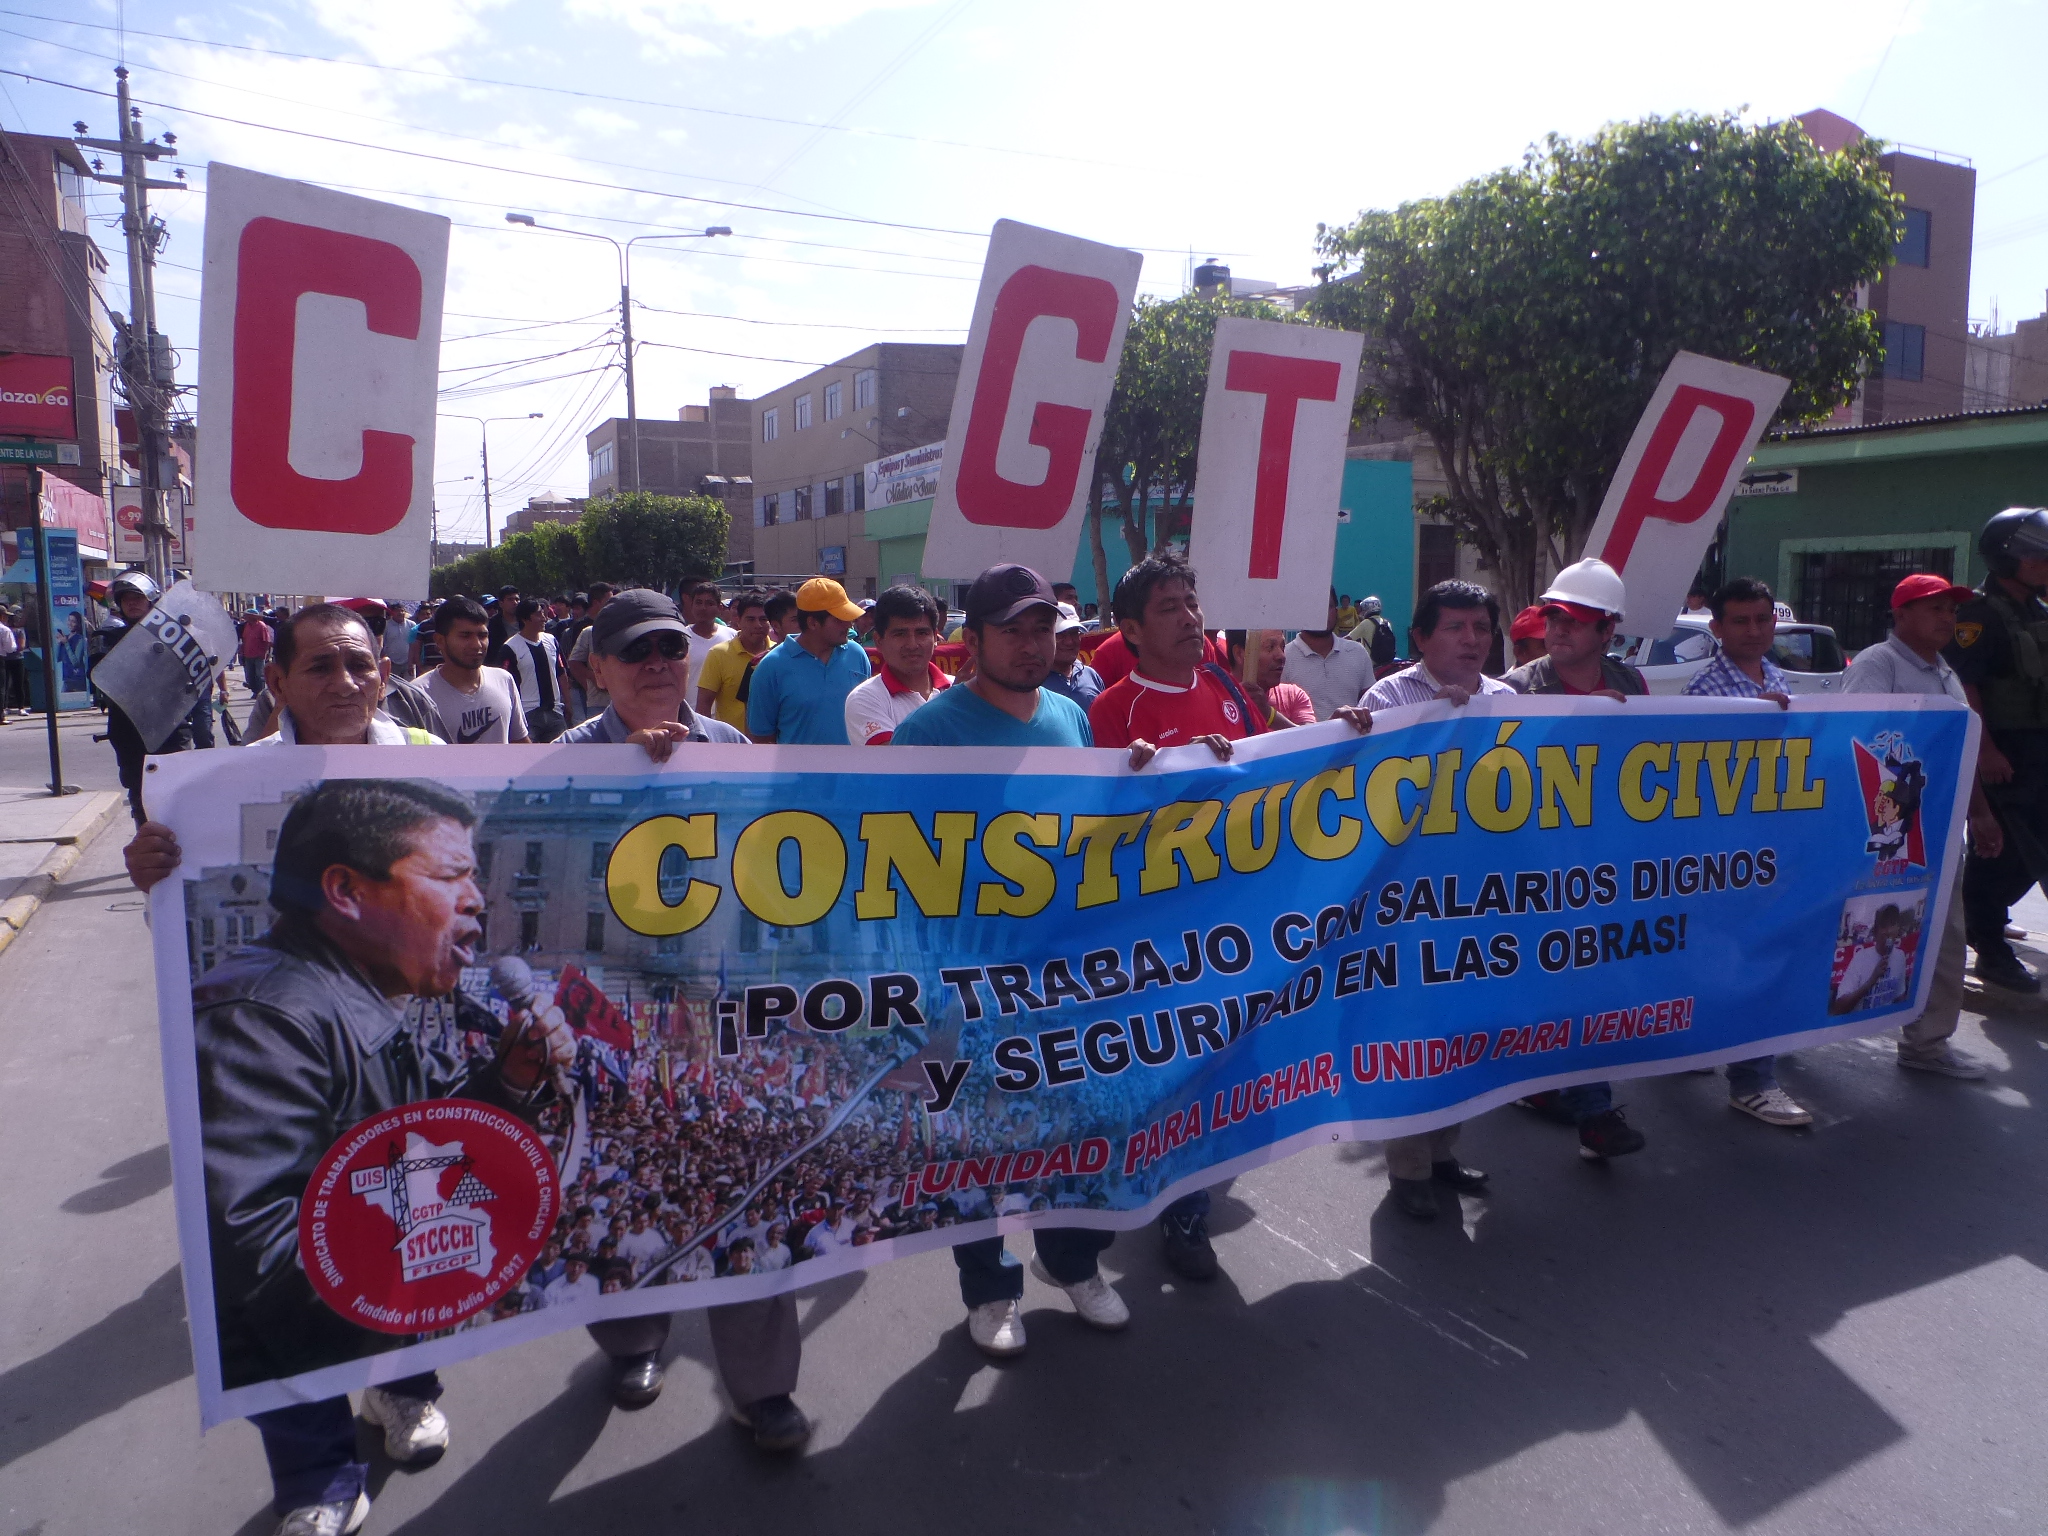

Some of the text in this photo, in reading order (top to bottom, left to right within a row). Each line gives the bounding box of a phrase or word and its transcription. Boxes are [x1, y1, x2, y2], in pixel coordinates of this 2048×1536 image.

[14, 449, 25, 458] DE
[25, 449, 34, 458] LA
[35, 449, 53, 459] VEGA
[230, 216, 422, 534] C
[955, 265, 1119, 530] G
[1225, 350, 1341, 579] T
[1600, 384, 1755, 576] P
[462, 706, 492, 730] NIKE
[605, 721, 1826, 936] CONSTRUCCIÓN CIVIL
[717, 973, 926, 1058] ¡POR
[939, 922, 1253, 1022] TRABAJO
[1271, 891, 1370, 963] CON
[1376, 862, 1618, 926] SALARIOS
[1631, 847, 1777, 901] DIGNOS
[921, 913, 1688, 1115] y SEGURIDAD EN LAS OBRAS!
[355, 1170, 382, 1188] UIS
[900, 996, 1695, 1208] ¡UNIDAD PARA LUCHAR, UNIDAD PARA VENCER!
[312, 1107, 551, 1288] SINDICATO DE TRABAJADORES EN CONSTRUCCION CIVIL DE CHICLAYO
[350, 1253, 525, 1325] Fundado el 16 de Julio de 1917
[407, 1224, 474, 1262] STCCCH
[412, 1203, 443, 1221] CGTP
[412, 1254, 472, 1278] FTCCP
